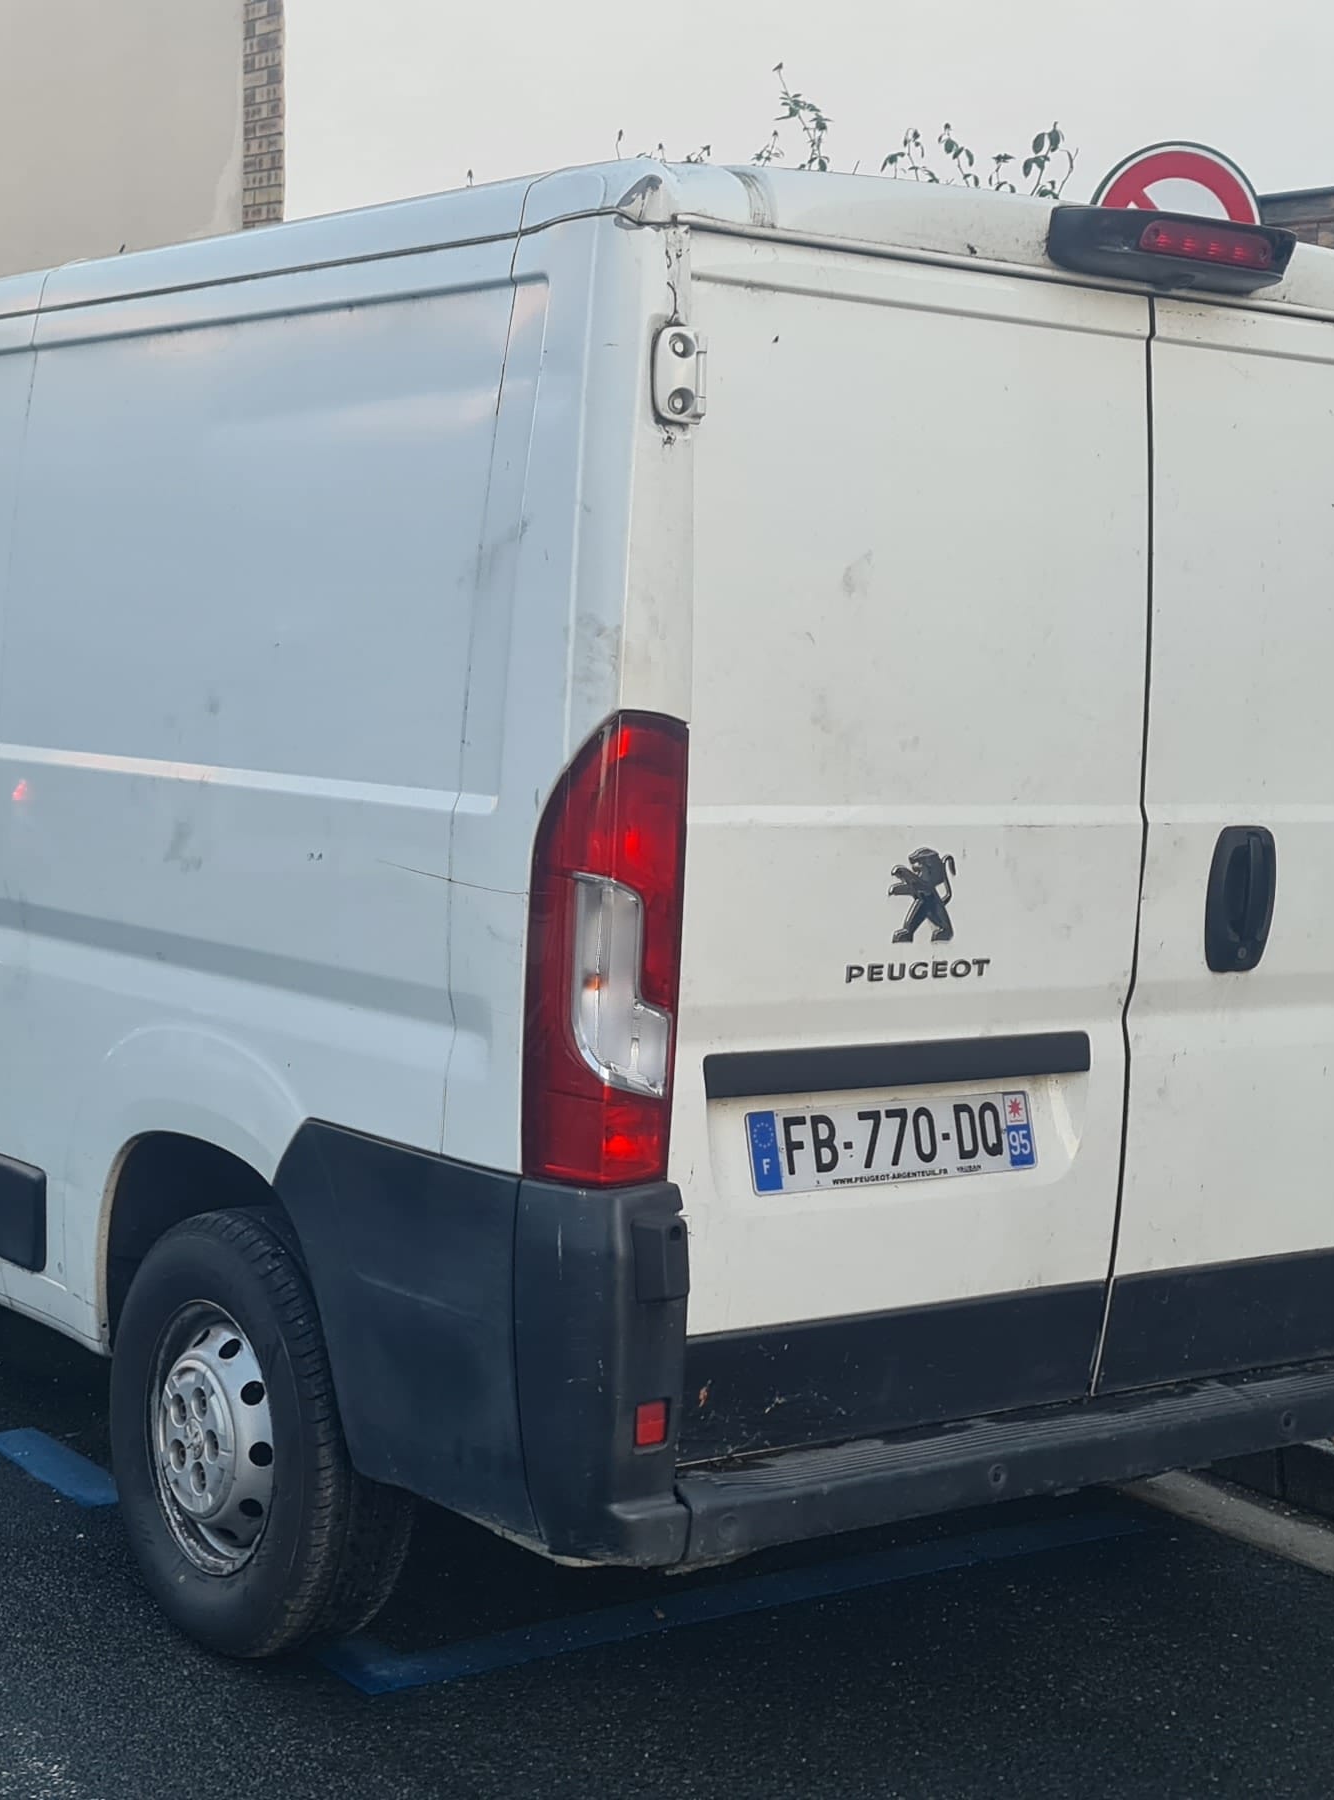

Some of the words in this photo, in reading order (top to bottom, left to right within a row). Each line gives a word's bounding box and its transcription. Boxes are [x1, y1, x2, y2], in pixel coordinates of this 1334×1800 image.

[845, 958, 991, 984] PEUGEOT
[782, 1101, 1004, 1176] FB-770-DQ
[1009, 1130, 1031, 1156] 95
[762, 1158, 771, 1175] F
